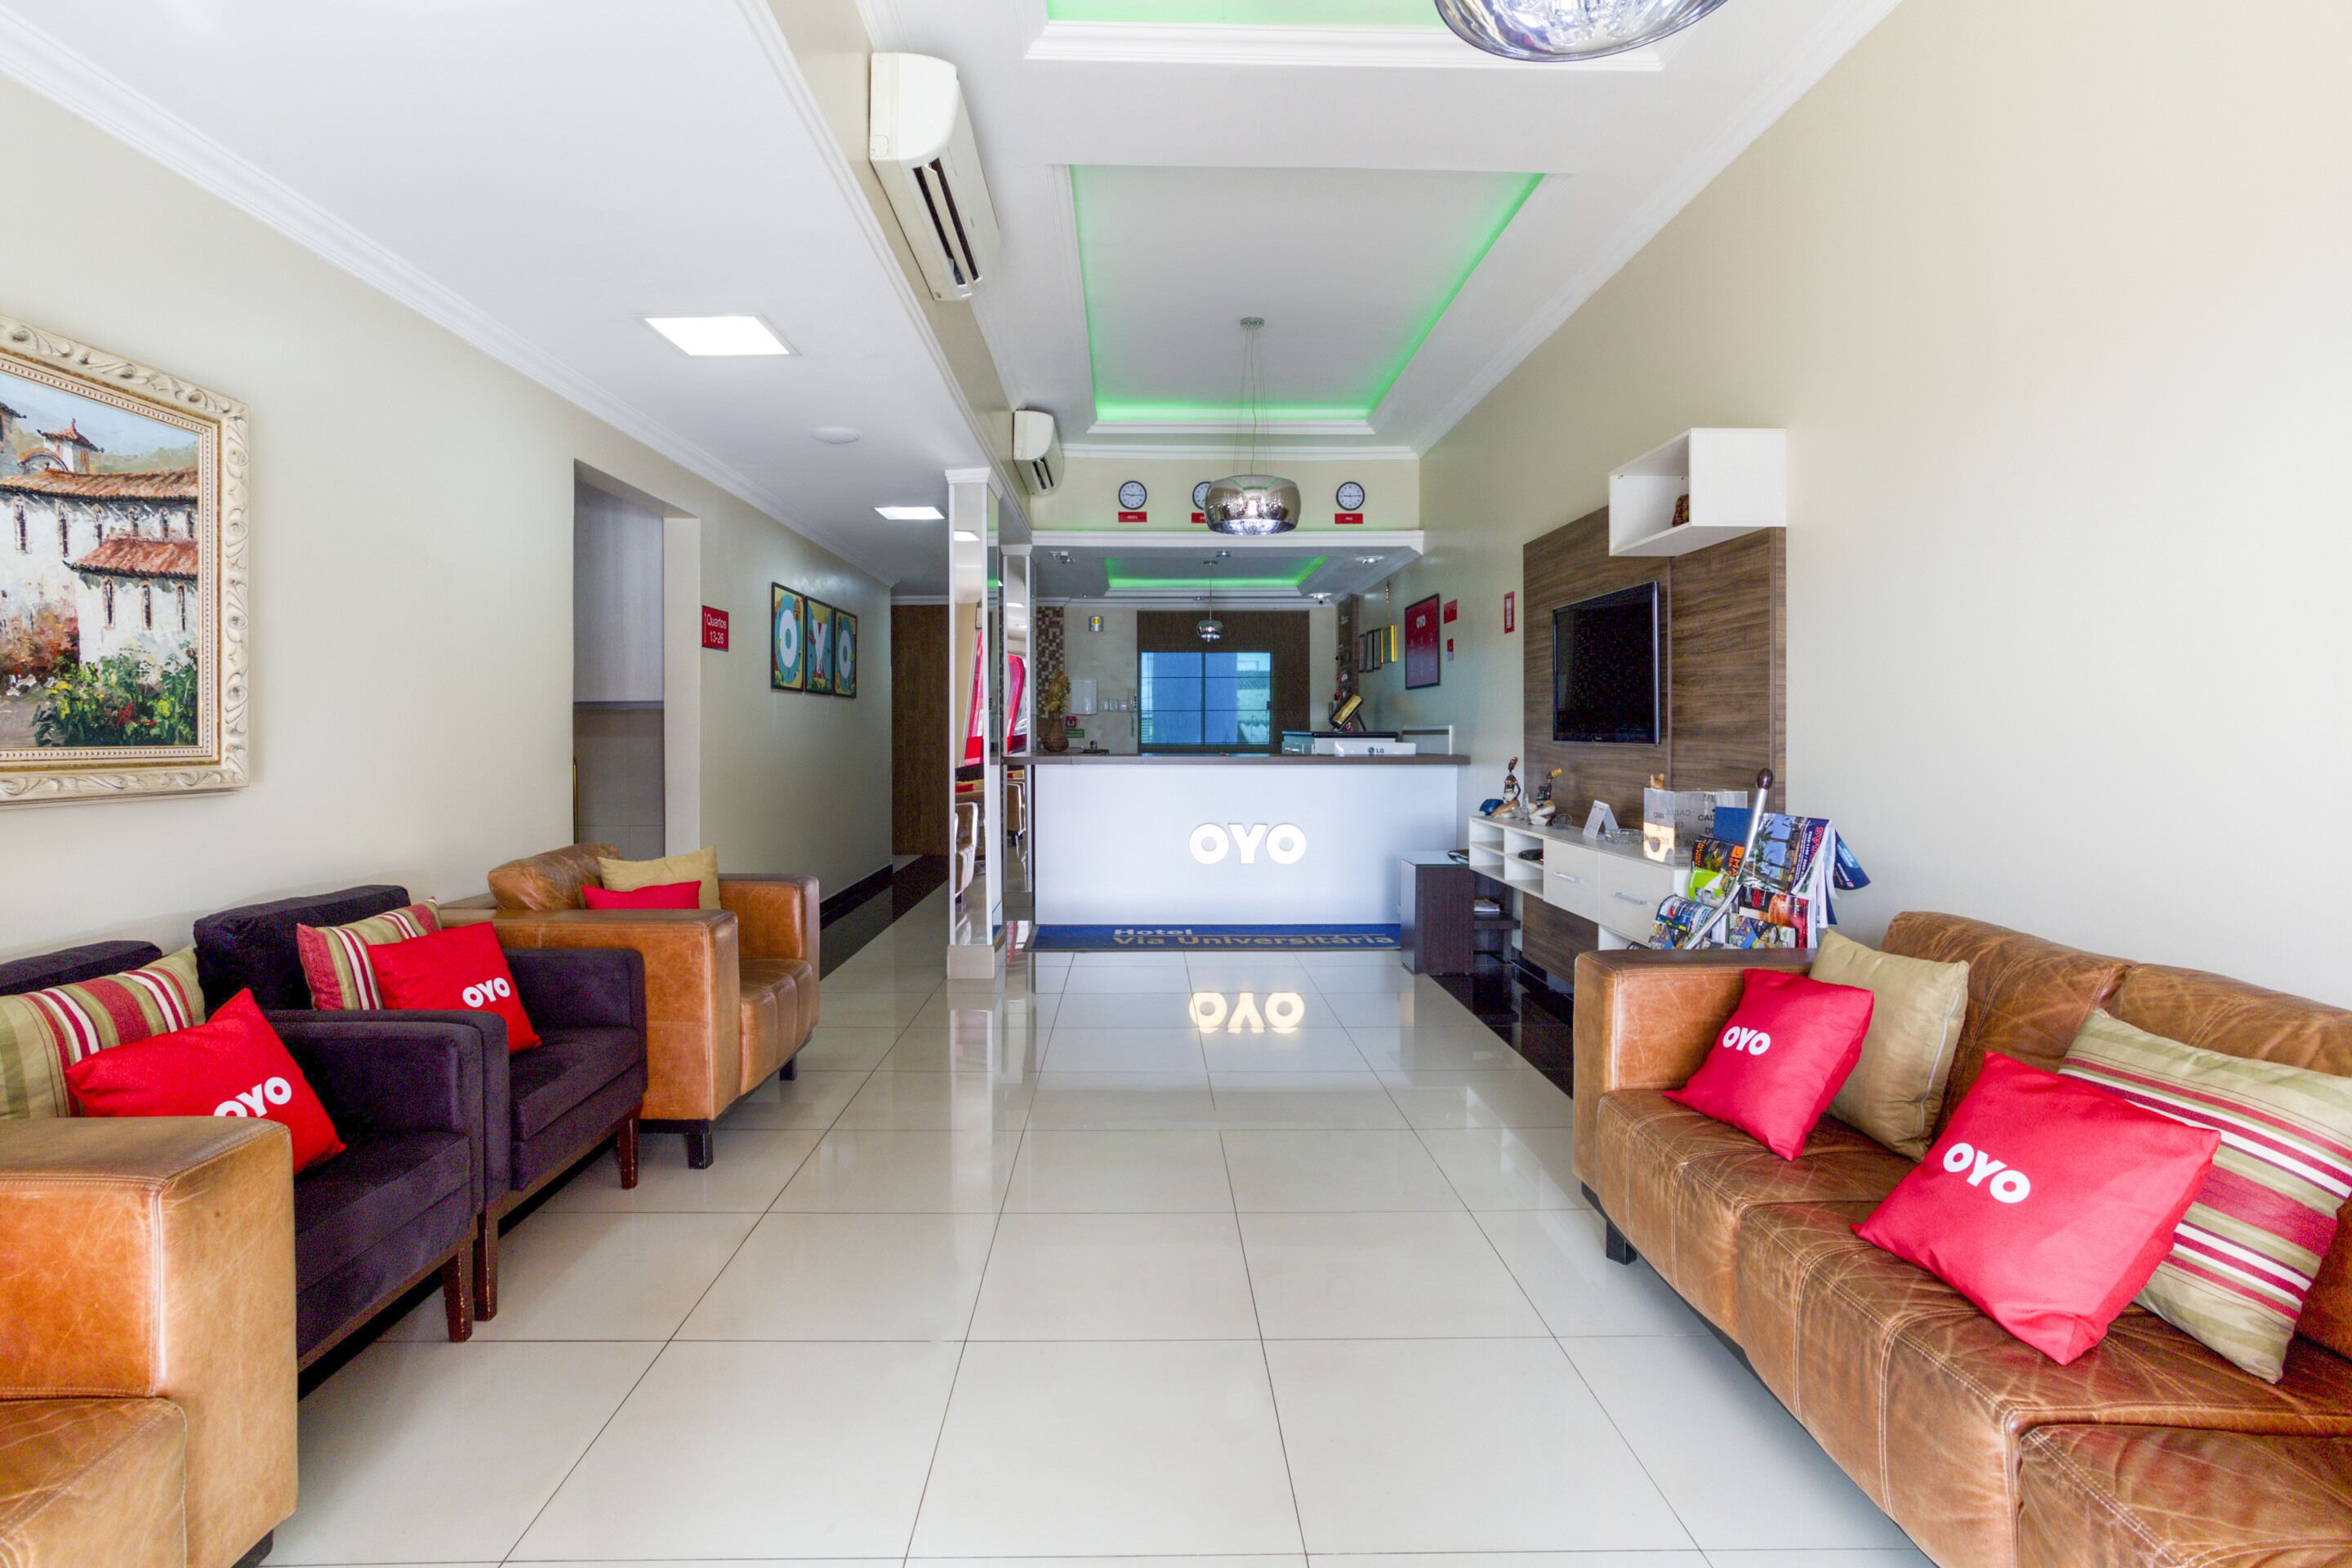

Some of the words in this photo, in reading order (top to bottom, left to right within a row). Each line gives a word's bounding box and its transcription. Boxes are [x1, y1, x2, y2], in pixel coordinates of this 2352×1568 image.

[706, 613, 727, 629] Quartos
[1416, 615, 1426, 629] OYO
[710, 630, 724, 644] 13-26
[1188, 822, 1307, 866] OYO
[1112, 936, 1165, 945] Via
[1178, 934, 1396, 945] Universitária
[462, 977, 510, 1008] OYO
[1722, 1026, 1771, 1056] OYO
[214, 1076, 292, 1118] OYO
[1943, 1143, 2031, 1204] OYO
